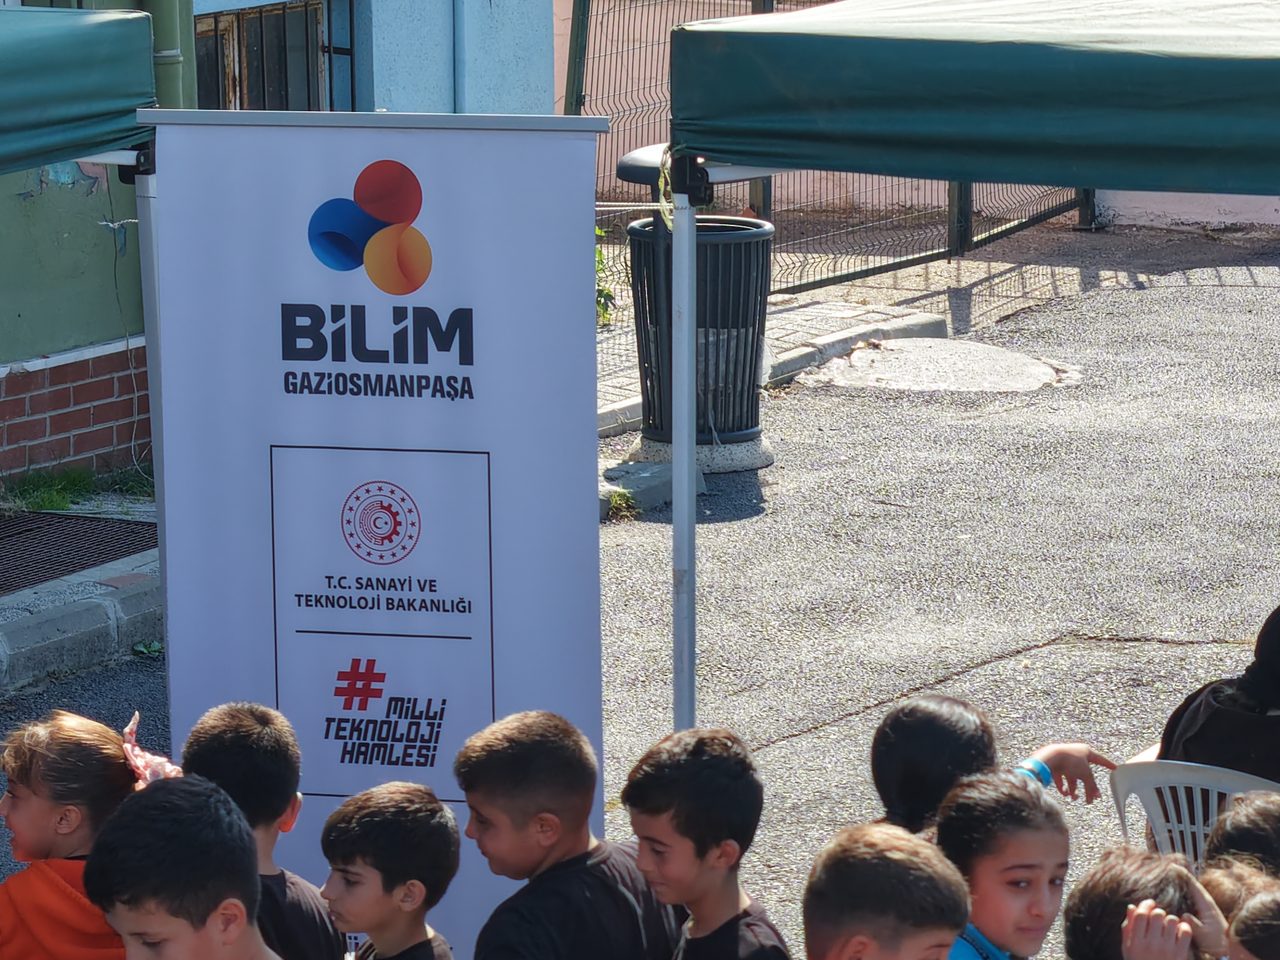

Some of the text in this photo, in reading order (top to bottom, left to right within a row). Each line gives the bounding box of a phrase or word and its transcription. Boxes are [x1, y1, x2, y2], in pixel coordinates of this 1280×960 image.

[283, 371, 475, 401] GAZİOSMANPAŞA
[325, 575, 437, 593] T.C. SANAYİ VE
[294, 594, 472, 614] TEKNOLOJİ BAKANLIĞI
